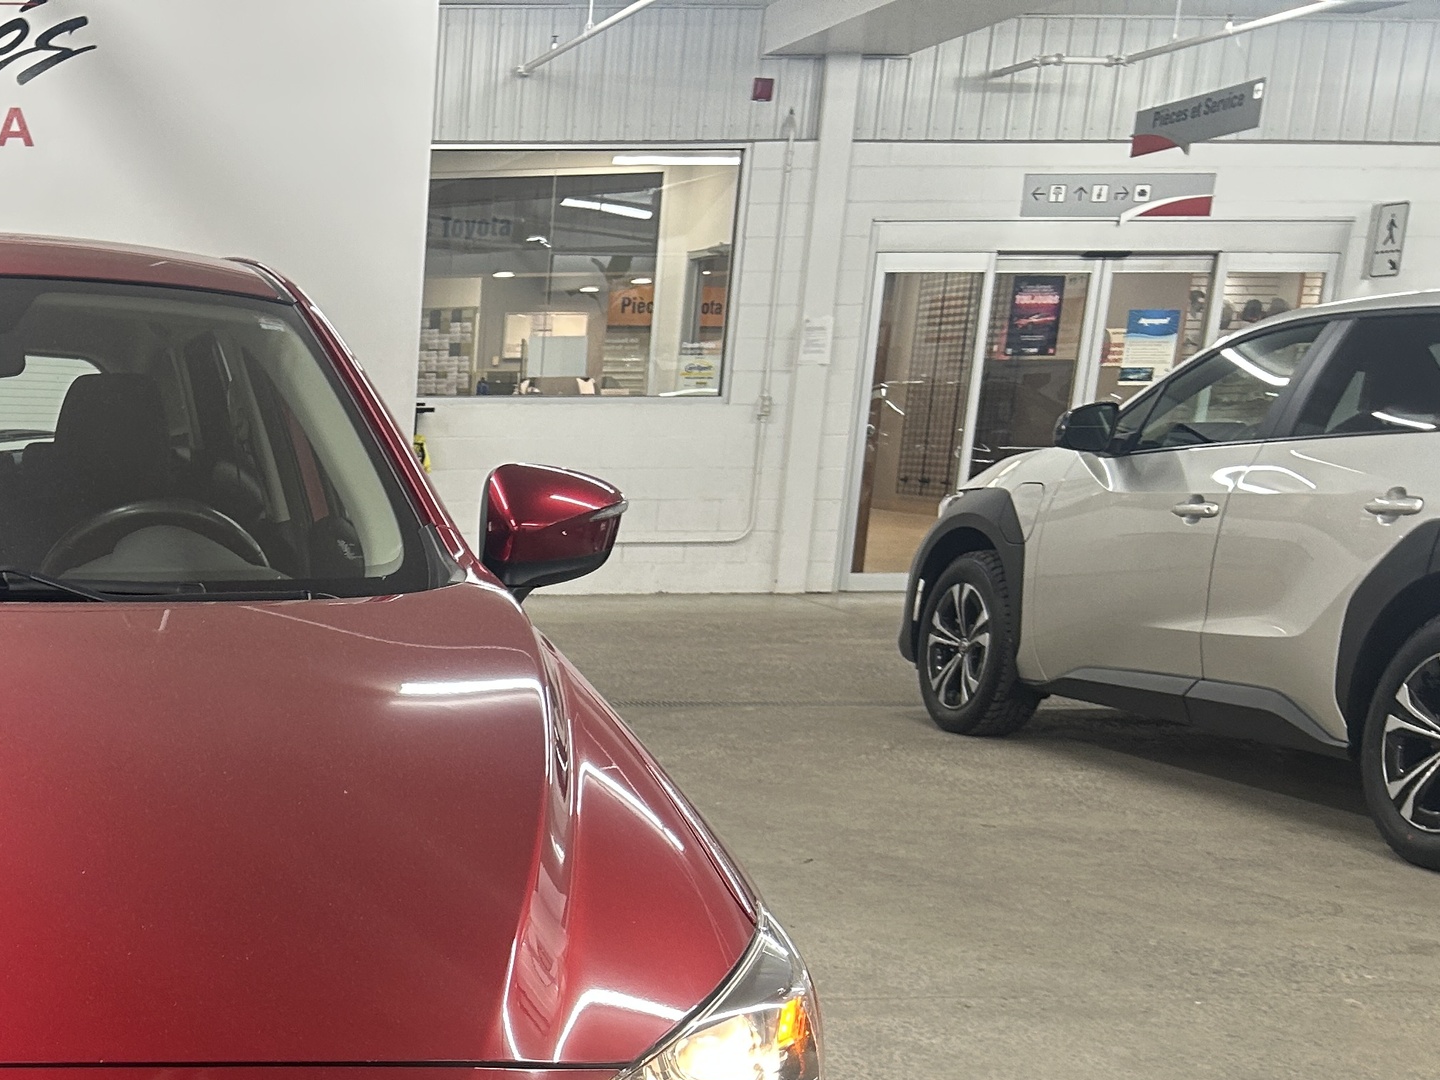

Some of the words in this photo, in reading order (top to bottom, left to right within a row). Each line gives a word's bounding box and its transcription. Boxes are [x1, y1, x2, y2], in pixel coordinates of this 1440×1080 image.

[1190, 102, 1202, 119] et
[1203, 91, 1245, 116] Service
[440, 216, 513, 240] Toyota
